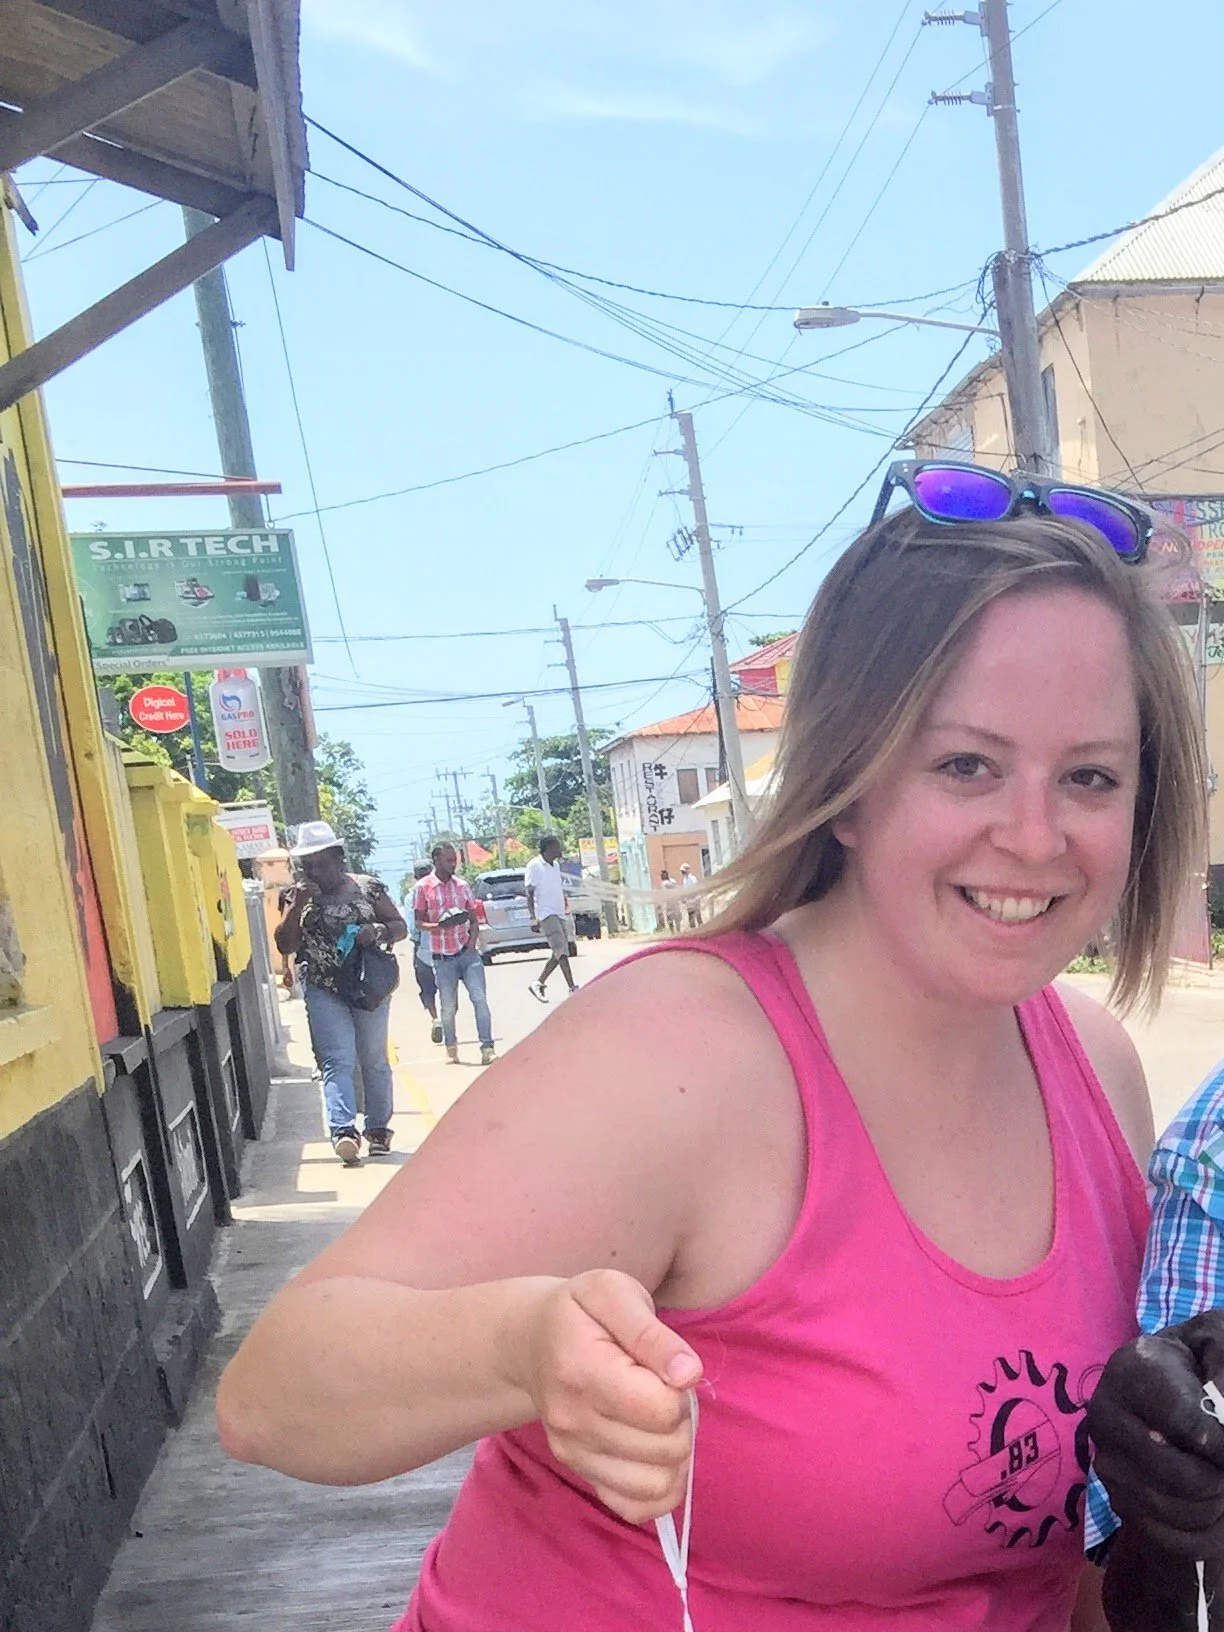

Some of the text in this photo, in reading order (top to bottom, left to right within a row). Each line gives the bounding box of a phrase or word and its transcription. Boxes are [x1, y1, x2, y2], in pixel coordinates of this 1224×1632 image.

[180, 533, 280, 556] TECH
[139, 711, 185, 721] Credit Here
[224, 729, 258, 740] SOLD
[225, 740, 259, 750] HERE
